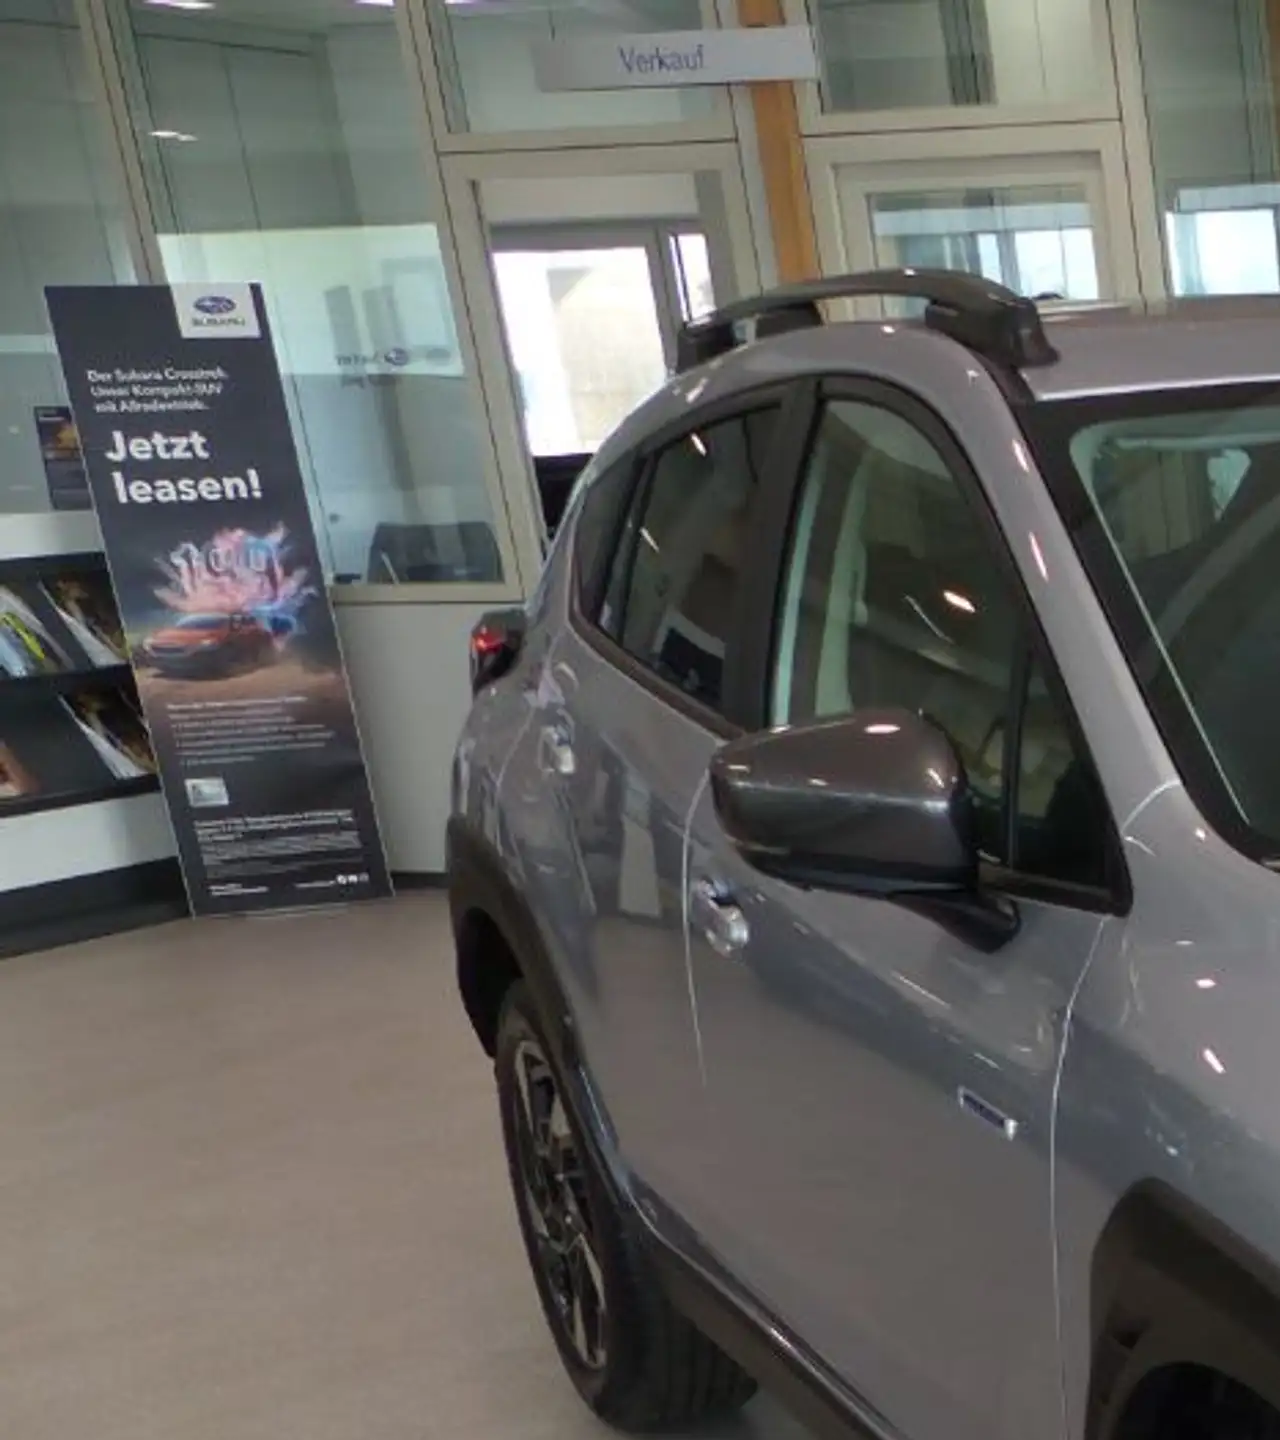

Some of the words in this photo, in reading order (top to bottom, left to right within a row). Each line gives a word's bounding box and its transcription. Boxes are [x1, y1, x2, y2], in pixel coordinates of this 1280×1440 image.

[618, 44, 704, 74] Verkauf
[131, 382, 224, 399] KopktUV
[105, 430, 210, 462] Jetzt
[110, 467, 262, 503] leasen!
